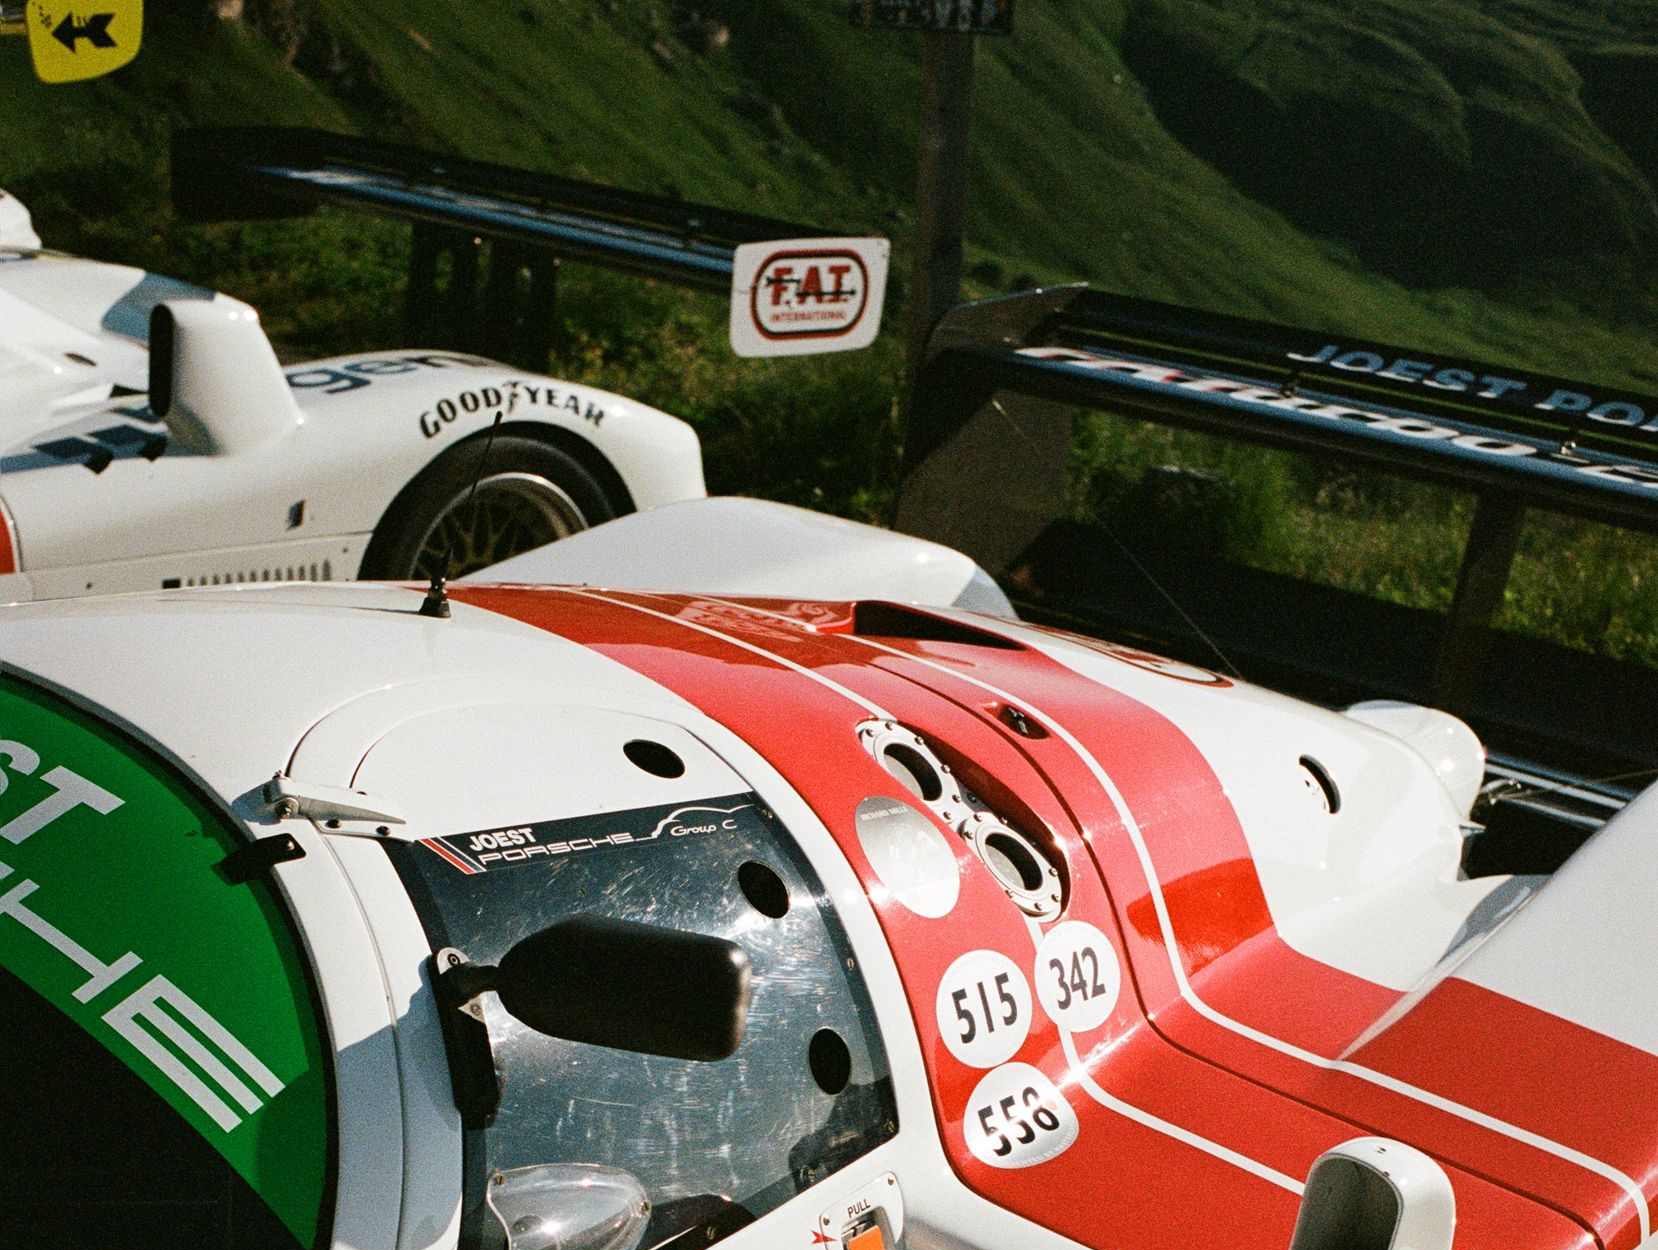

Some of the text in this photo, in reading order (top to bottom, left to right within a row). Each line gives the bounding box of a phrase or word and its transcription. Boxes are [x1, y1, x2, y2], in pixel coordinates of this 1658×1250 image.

[1286, 345, 1527, 399] JOEST
[420, 382, 605, 439] GOODYEAR
[469, 827, 538, 852] JOEST
[479, 819, 738, 866] PORSCHE Group C
[1049, 946, 1107, 1010] 342
[951, 971, 1018, 1044] 515
[847, 1198, 871, 1218] PULL
